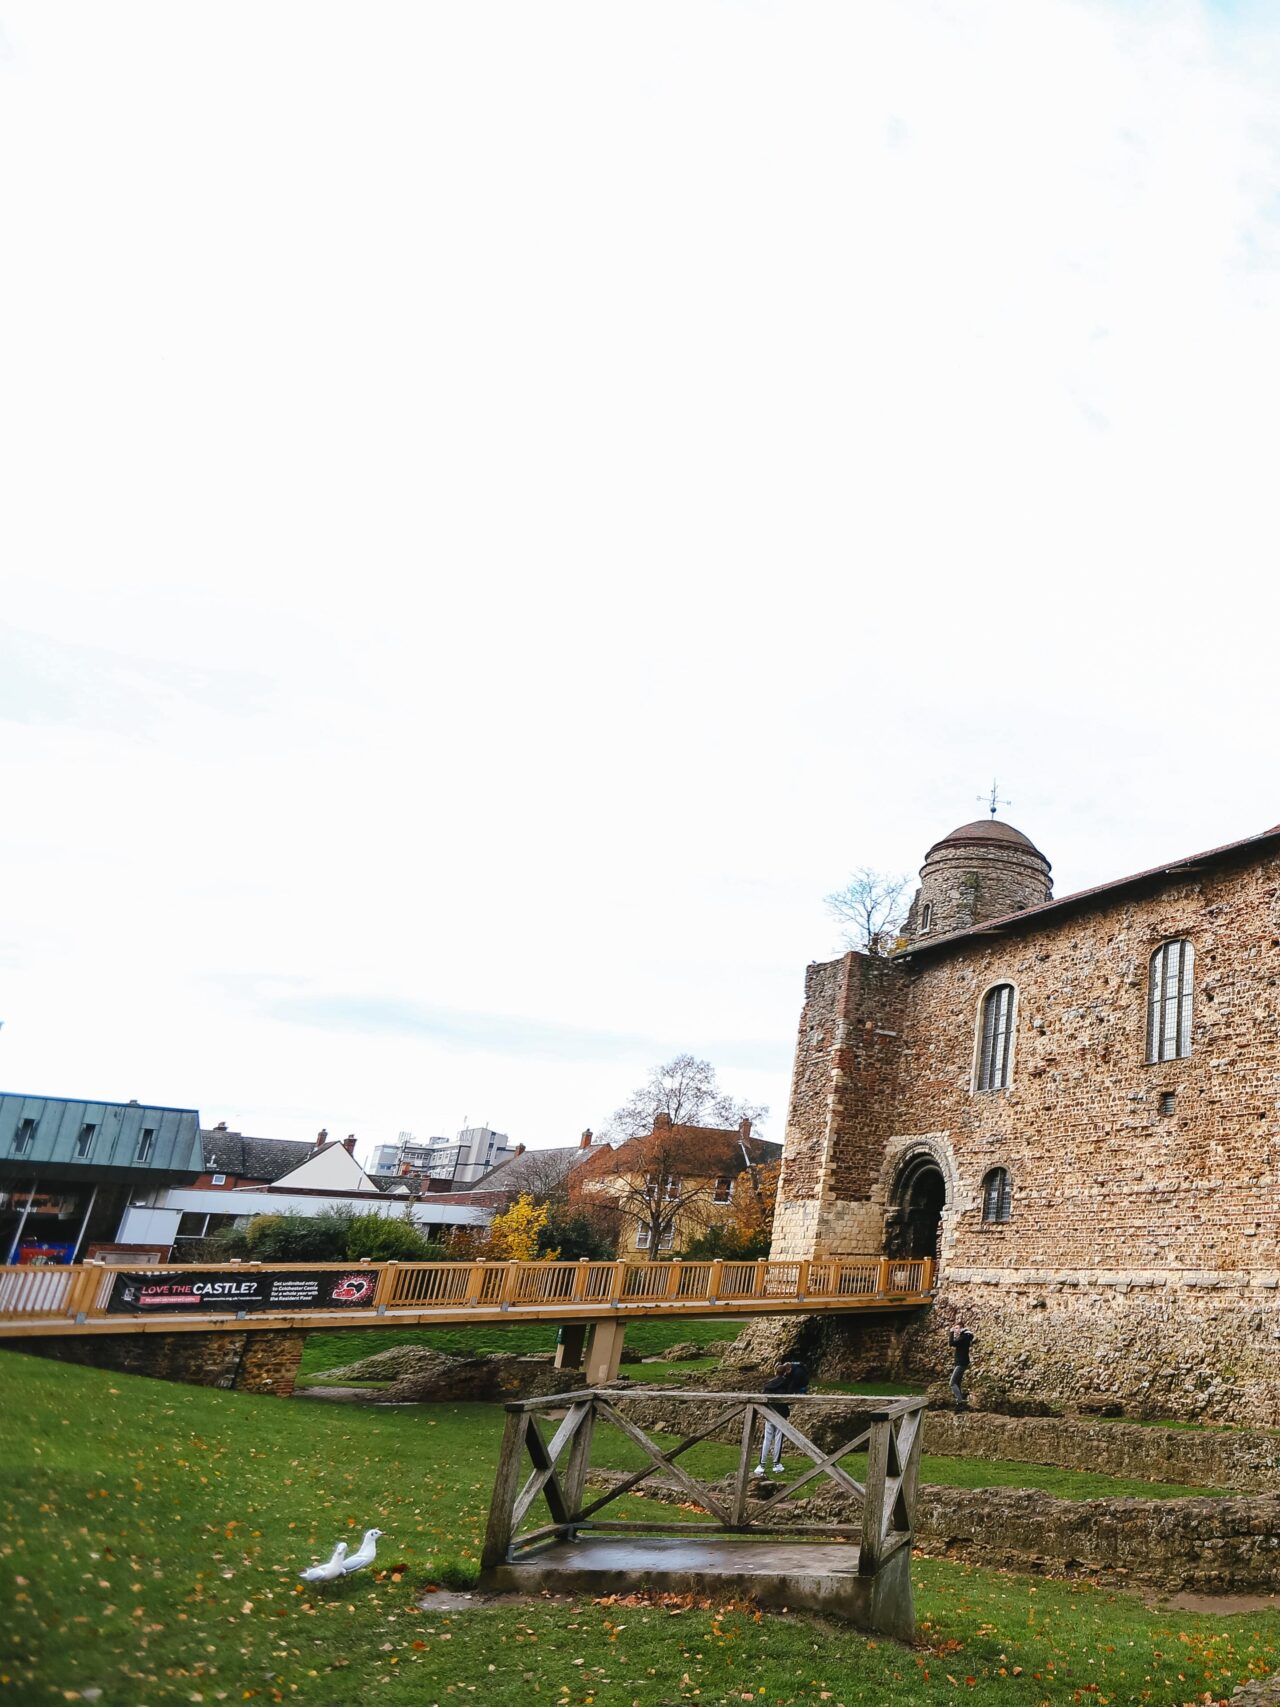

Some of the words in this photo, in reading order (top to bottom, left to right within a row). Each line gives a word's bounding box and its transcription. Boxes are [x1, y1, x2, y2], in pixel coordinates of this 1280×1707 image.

[141, 1286, 169, 1294] LOVE
[172, 1285, 192, 1293] THE
[193, 1282, 258, 1294] CASTLE?
